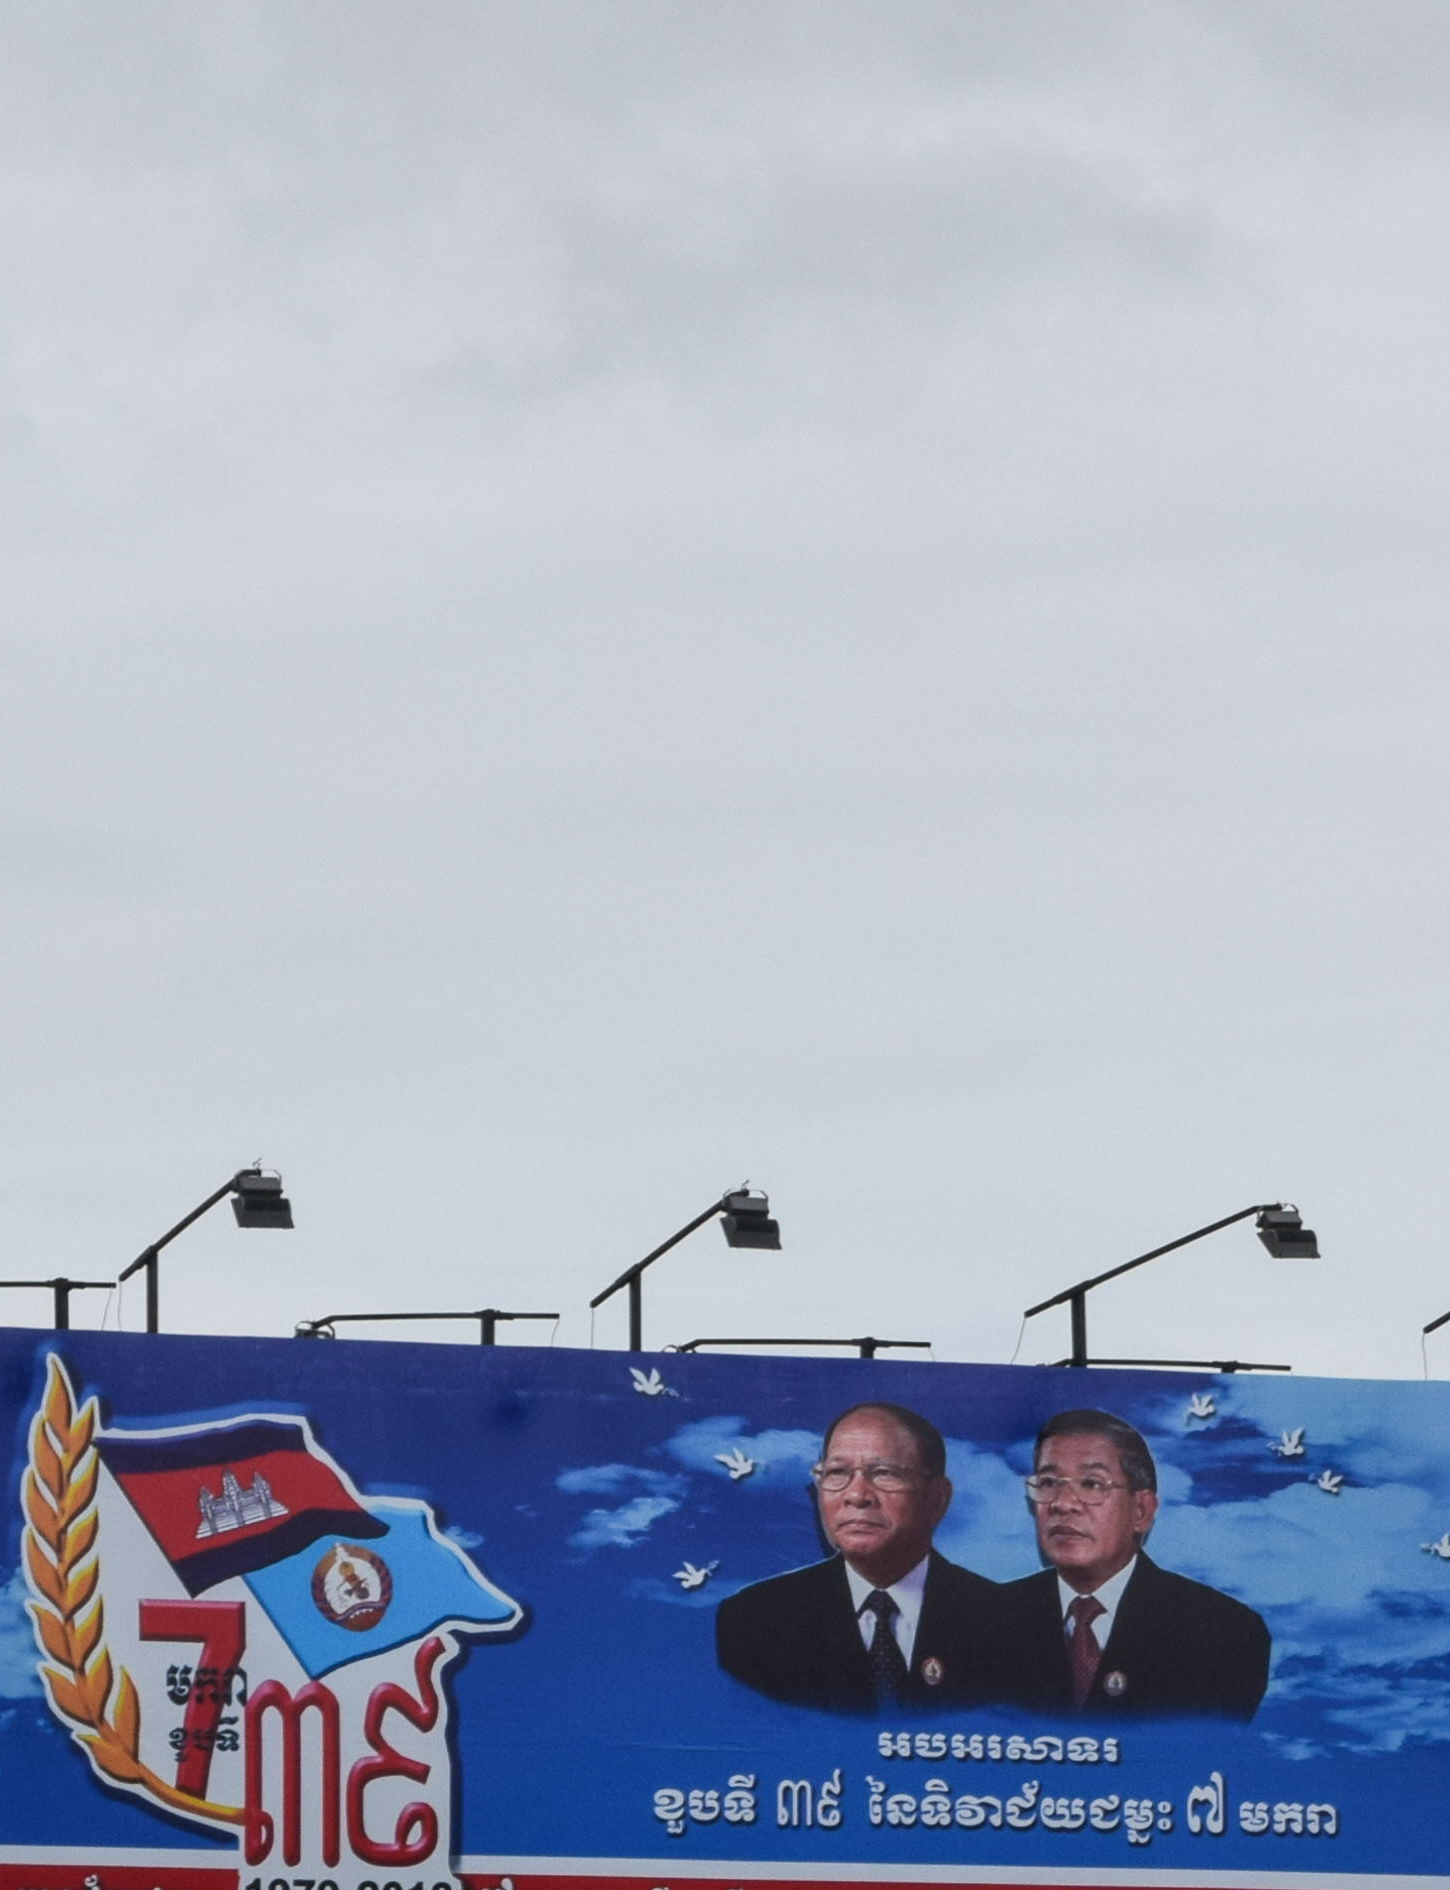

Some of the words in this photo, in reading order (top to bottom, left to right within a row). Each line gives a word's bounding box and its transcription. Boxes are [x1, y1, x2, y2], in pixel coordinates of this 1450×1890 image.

[139, 1599, 246, 1800] 7
[244, 1636, 447, 1868] ៣៩
[878, 1731, 1119, 1763] អបអរសាទរ
[653, 1774, 756, 1834] ខួបទី
[776, 1769, 843, 1828] ៣៩
[1186, 1771, 1226, 1835] ៧
[1238, 1799, 1339, 1837] មករា
